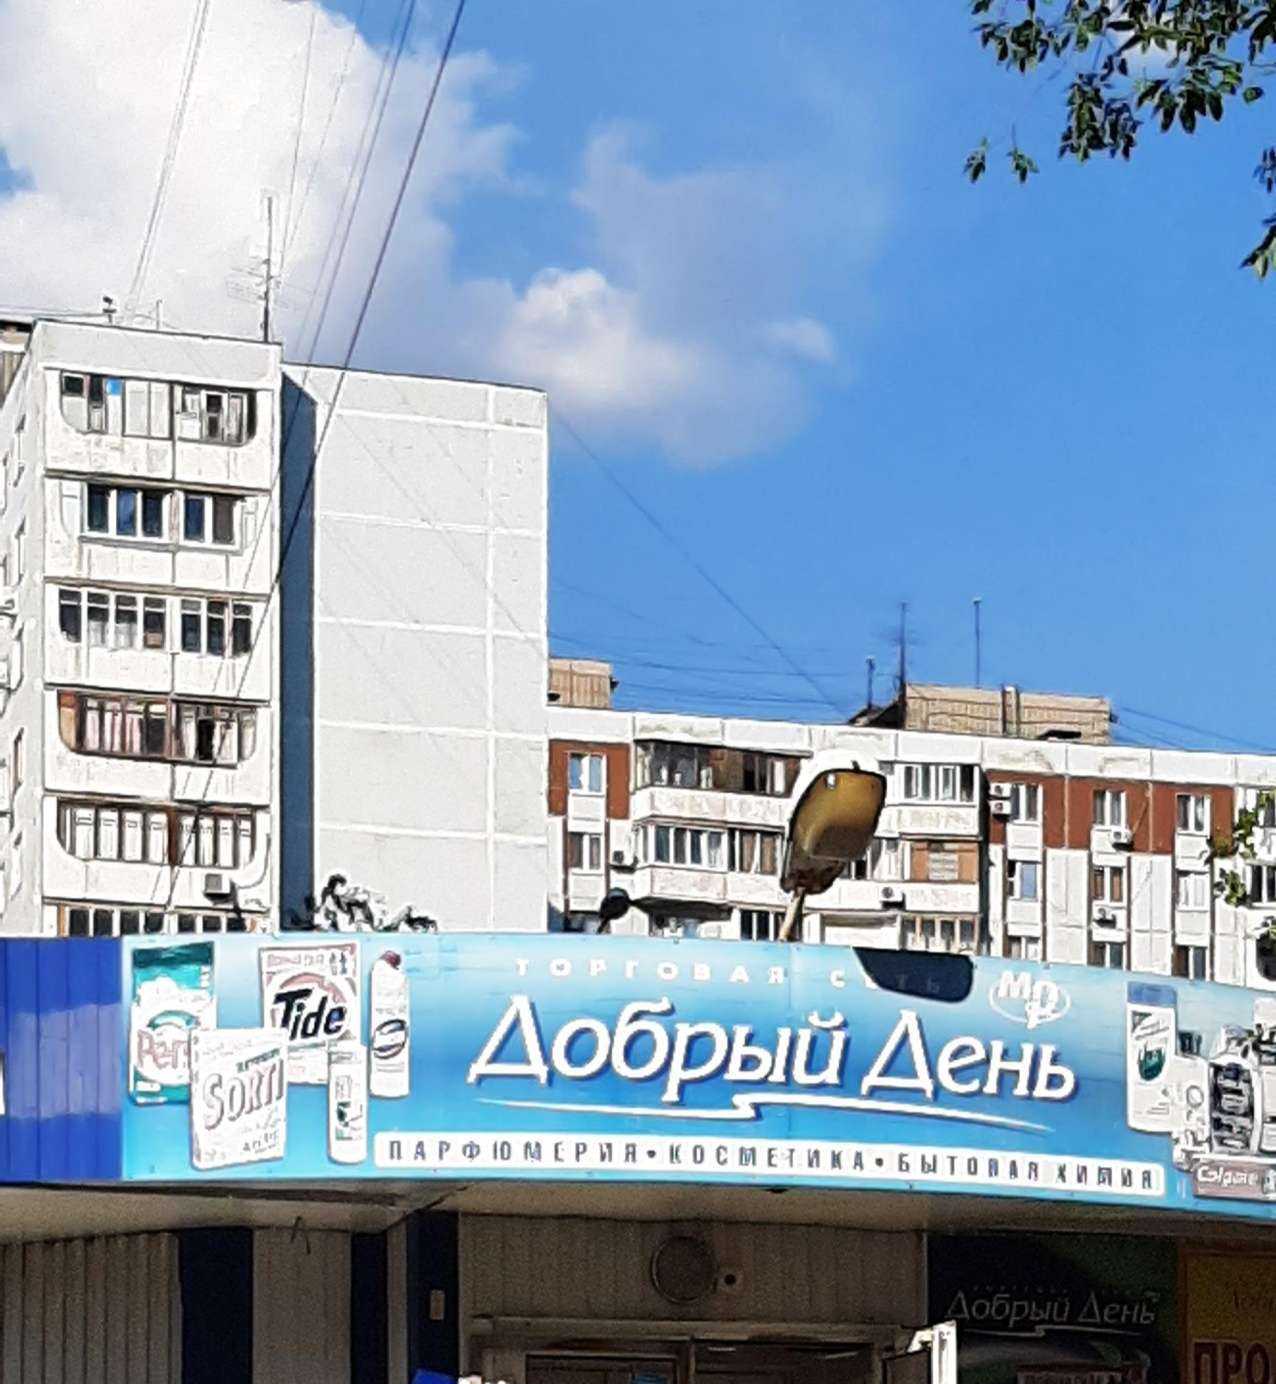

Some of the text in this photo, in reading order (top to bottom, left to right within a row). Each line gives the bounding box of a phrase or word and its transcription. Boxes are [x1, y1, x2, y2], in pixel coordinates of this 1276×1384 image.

[515, 959, 787, 985] ТОРГОВАЯ
[274, 988, 346, 1041] Tide
[466, 994, 1079, 1104] Добрый День
[389, 1141, 1153, 1190] ПАРФЮМЕРИЯ КОСМЕТИКА БЫТОВАЯ ХИМИЯ
[945, 1290, 1155, 1326] Добрый День
